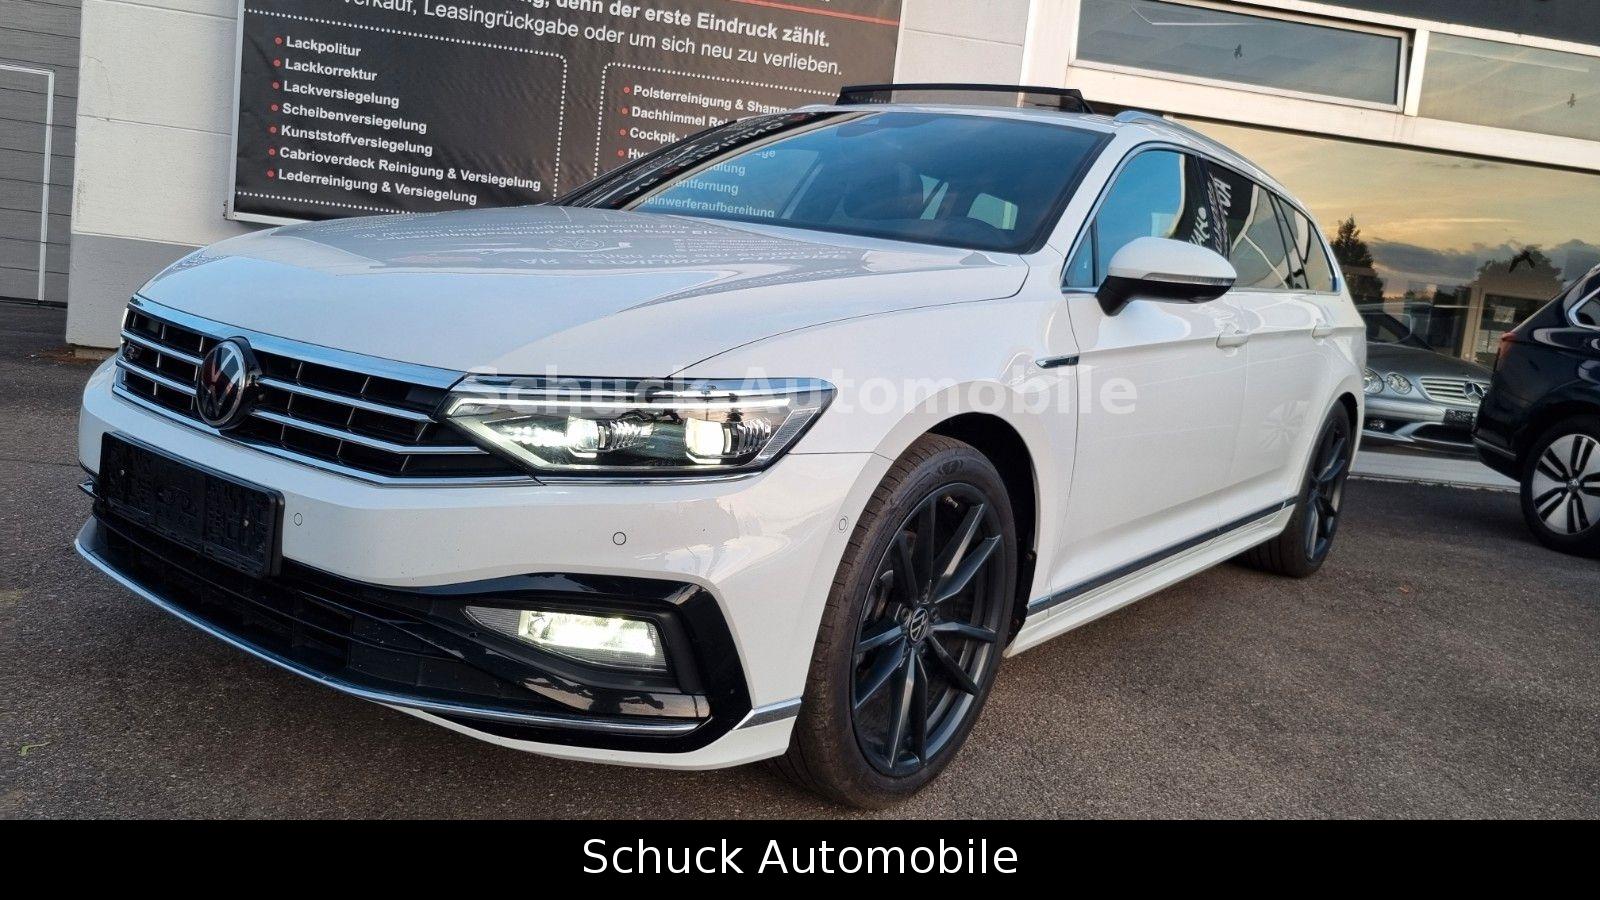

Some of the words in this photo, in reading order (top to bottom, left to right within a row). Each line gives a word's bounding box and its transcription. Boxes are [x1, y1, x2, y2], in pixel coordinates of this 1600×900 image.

[344, 0, 417, 16] erkauf,
[424, 0, 578, 38] Leasingrückgabe
[584, 21, 625, 44] oder
[629, 31, 656, 48] um
[661, 34, 696, 55] sich
[701, 45, 733, 61] neu
[738, 48, 757, 64] zu
[763, 51, 843, 76] verlieben.
[609, 1, 641, 19] der
[645, 8, 692, 27] erste
[697, 12, 778, 40] Eindruck
[782, 26, 830, 48] zählt.
[286, 36, 361, 58] Lackpolitur
[285, 58, 378, 82] Lackkorrektur
[283, 80, 400, 109] Lackversiegelung
[633, 84, 732, 111] Polsterreinigung
[735, 98, 745, 110] &
[747, 100, 793, 114] Shamp
[282, 102, 427, 134] Scheibenversiegelung
[632, 106, 706, 127] Dachhimmel
[281, 124, 433, 157] Kunststoffversiegelung
[629, 127, 680, 144] Cockpit-
[279, 146, 376, 170] Cabrioverdeck
[378, 159, 444, 181] Reinigung
[447, 168, 457, 180] &
[460, 169, 541, 192] Versiegelung
[278, 168, 378, 194] Lederreinigung
[381, 182, 392, 194] &
[395, 182, 478, 206] Versiegelung
